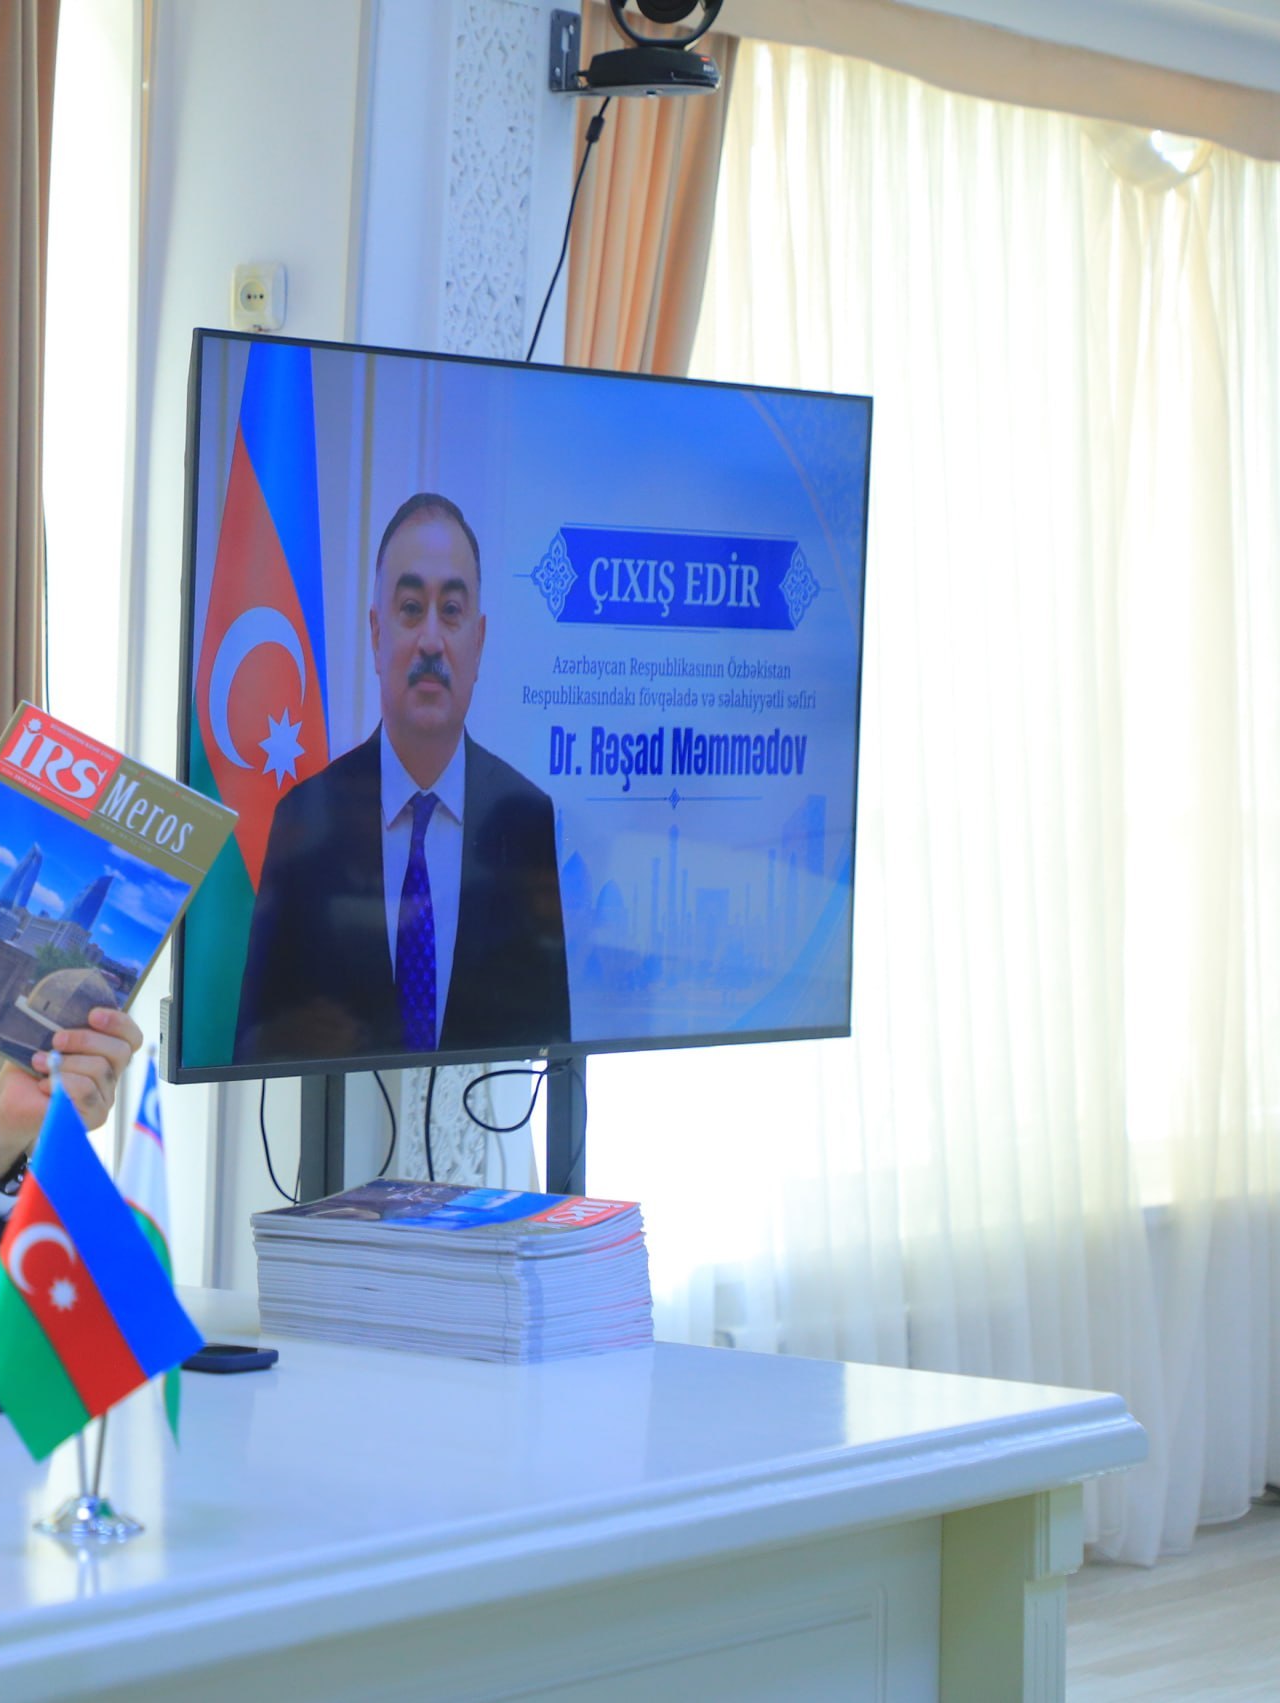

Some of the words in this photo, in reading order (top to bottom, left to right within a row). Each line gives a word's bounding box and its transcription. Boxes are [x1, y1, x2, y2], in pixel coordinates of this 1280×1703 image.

[588, 557, 675, 617] ÇIXIŞ
[683, 552, 761, 608] EDİR
[522, 685, 636, 711] Respublikasındakı
[639, 686, 698, 713] fövqəladə
[701, 692, 716, 708] və
[718, 688, 785, 714] səlahiyyətli
[787, 689, 817, 710] səfiri
[552, 655, 626, 680] Azərbaycan
[630, 656, 724, 682] Respublikasının
[728, 655, 792, 680] Özbəkistan
[549, 725, 582, 776] Dr.
[590, 725, 665, 792] Rəşad
[670, 727, 808, 776] Məmmədov
[98, 773, 195, 854] Meros
